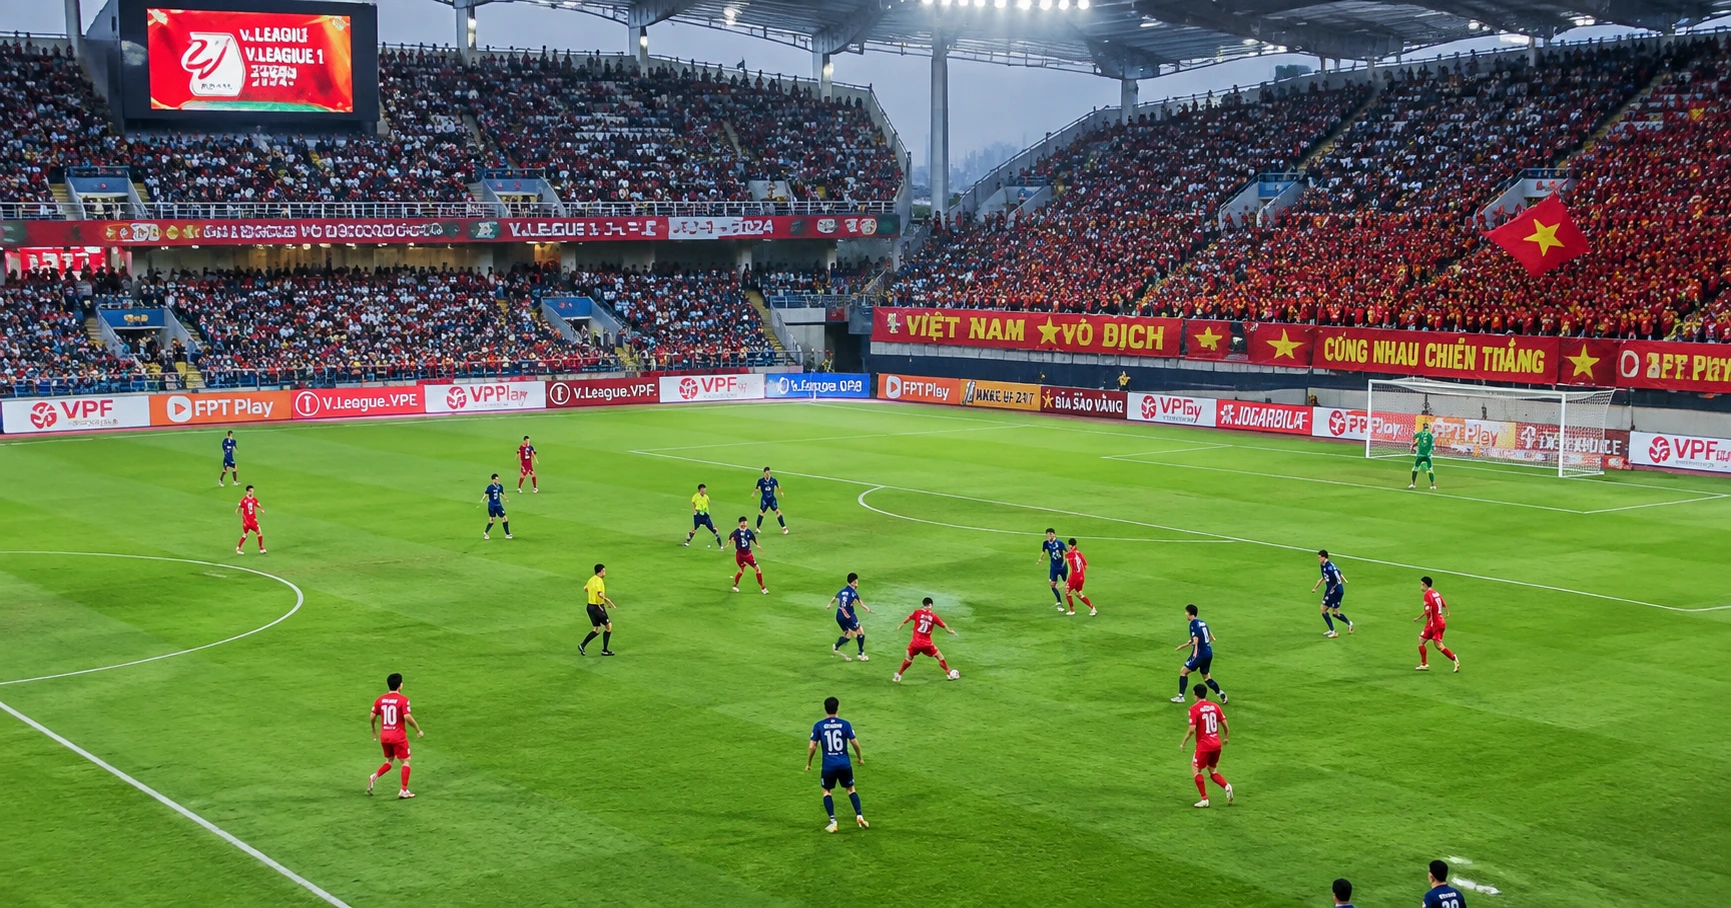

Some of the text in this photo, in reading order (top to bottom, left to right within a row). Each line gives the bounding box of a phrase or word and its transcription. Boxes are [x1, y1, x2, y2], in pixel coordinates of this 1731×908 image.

[969, 317, 1026, 341] NAM
[1372, 340, 1420, 367] NHAU
[700, 376, 737, 393] VPF
[902, 381, 925, 397] FPT
[59, 399, 114, 419] VPF
[194, 398, 274, 418] FPT Play
[1673, 438, 1718, 460] VPF
[380, 704, 397, 725] 10
[824, 729, 844, 752] 16
